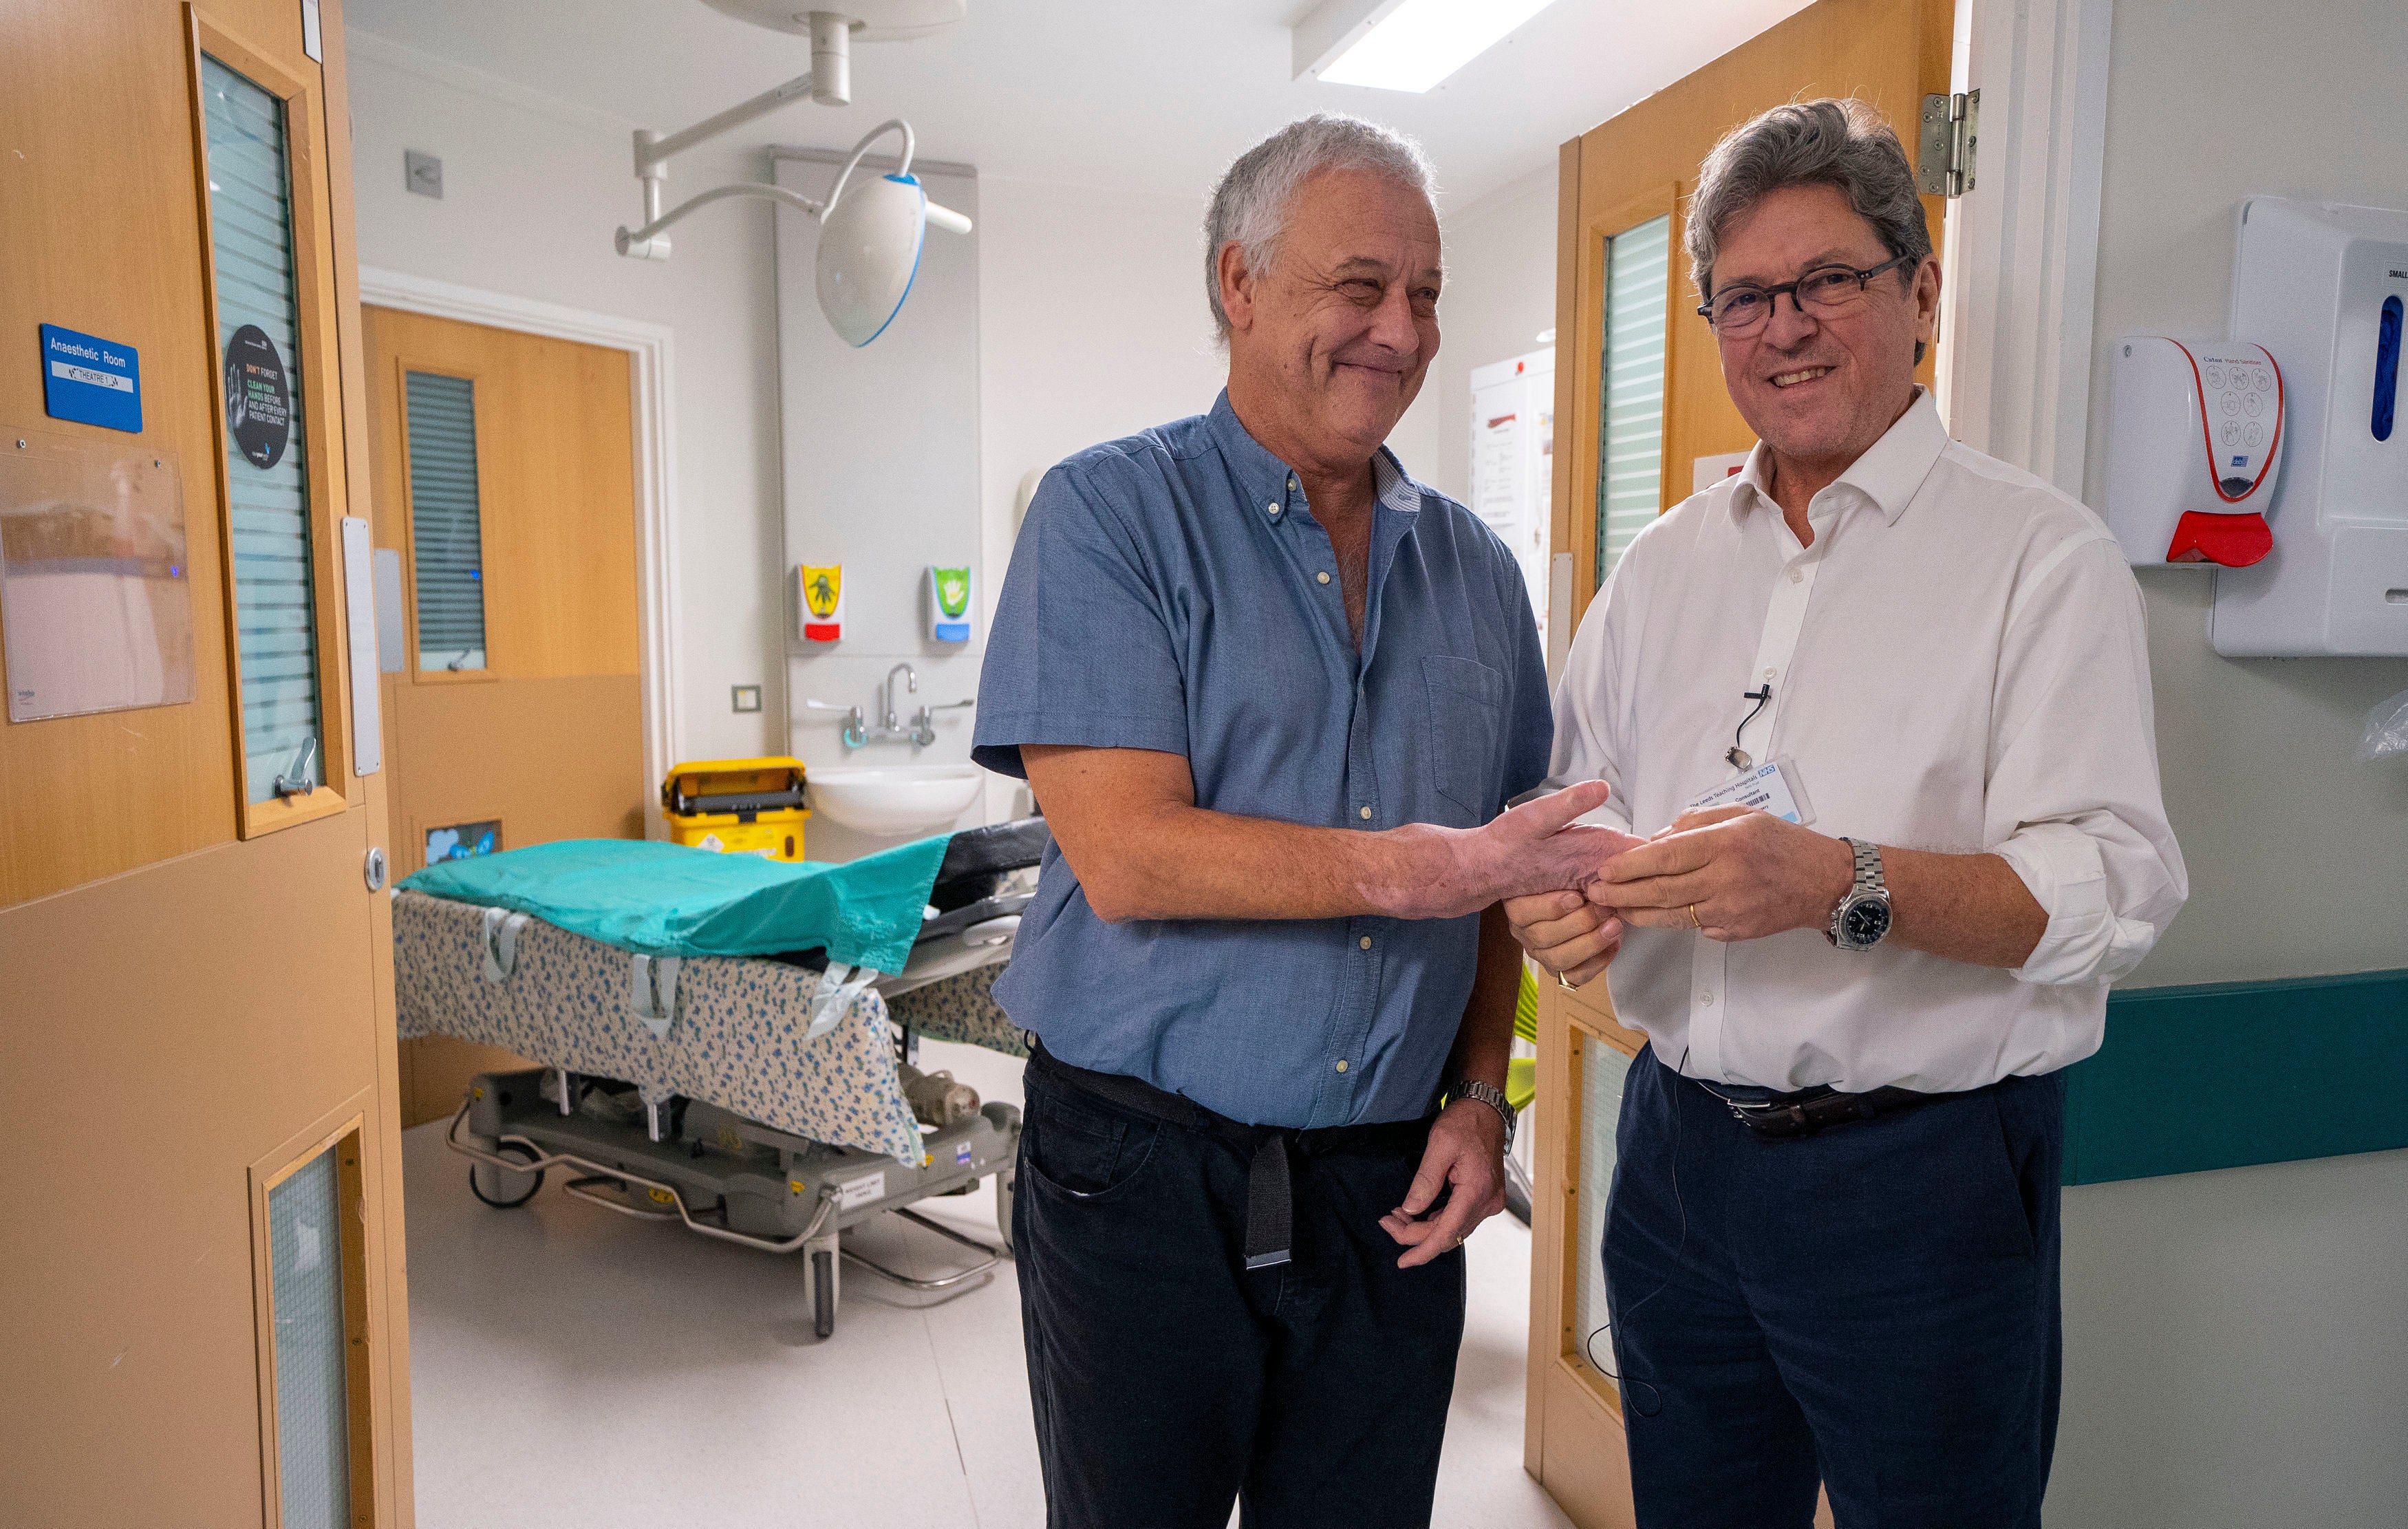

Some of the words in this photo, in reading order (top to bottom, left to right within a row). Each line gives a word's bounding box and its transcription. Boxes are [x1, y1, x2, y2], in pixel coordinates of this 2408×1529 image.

[2389, 270, 2408, 278] SMALL
[51, 336, 99, 361] Anaesthetic
[103, 351, 126, 367] Room
[80, 370, 105, 383] THEATRE
[246, 363, 260, 375] DON'T
[260, 367, 277, 380] FORGET
[247, 379, 263, 391] CLEAN
[263, 383, 275, 394] YOUR
[248, 389, 264, 401] HANDS
[264, 394, 281, 406] BEFORE
[248, 400, 259, 409] AND
[259, 403, 273, 414] AFTER
[273, 406, 287, 417] EVERY
[249, 410, 266, 422] PATIENT
[266, 415, 284, 427] CONTACT
[1759, 764, 1775, 778] NHS
[1699, 795, 1714, 805] Leeds
[1713, 785, 1735, 798] Teaching
[1734, 775, 1758, 789] Hospitals
[1734, 789, 1760, 802] Consultant
